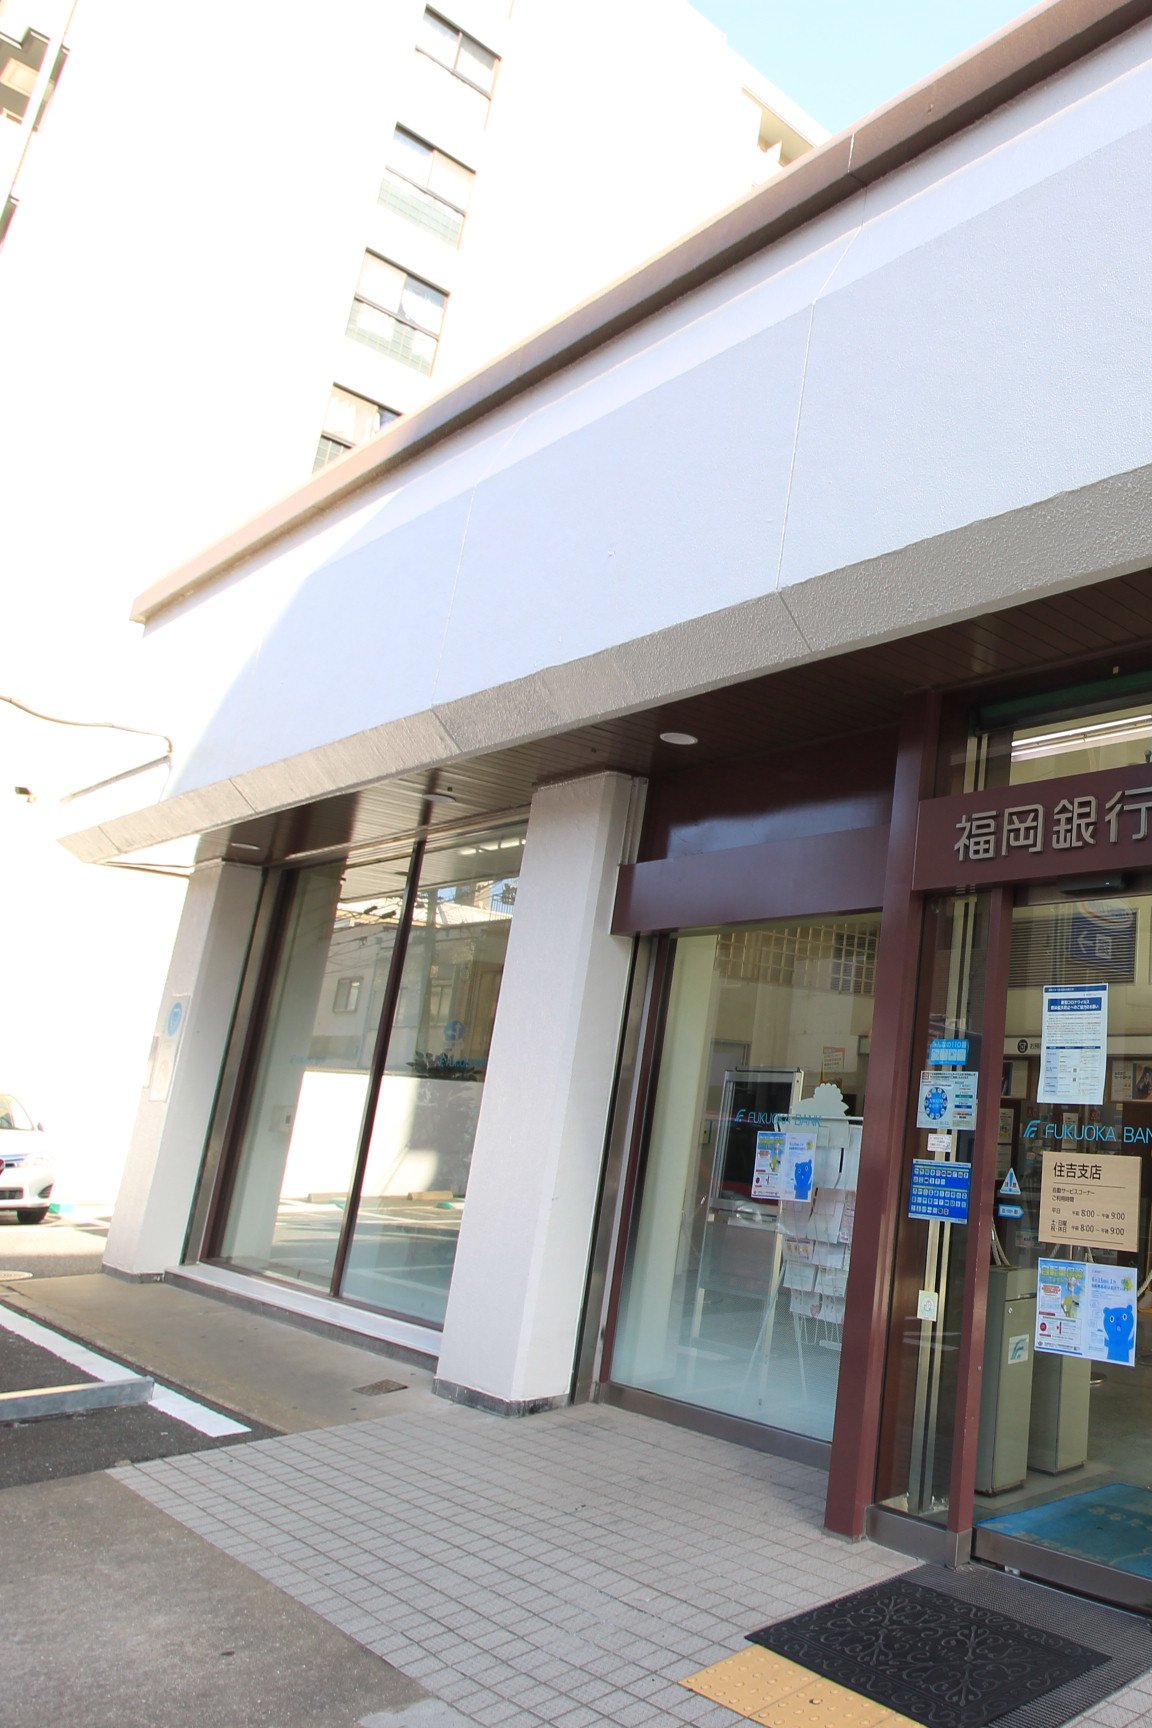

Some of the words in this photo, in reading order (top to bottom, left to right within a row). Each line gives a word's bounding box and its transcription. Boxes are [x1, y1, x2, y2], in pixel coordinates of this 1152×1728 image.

[1044, 1123, 1117, 1142] FUKUOKA
[1053, 1162, 1102, 1181] 住吉支店
[1052, 1187, 1095, 1196] 自動サービスコーナー
[1051, 1195, 1075, 1203] ご利用時間
[1051, 1207, 1061, 1215] 平日
[1080, 1209, 1095, 1218] 8:00
[1110, 1211, 1126, 1220] 9:00
[1080, 1224, 1095, 1233] 8:00
[1110, 1226, 1125, 1236] 9:00
